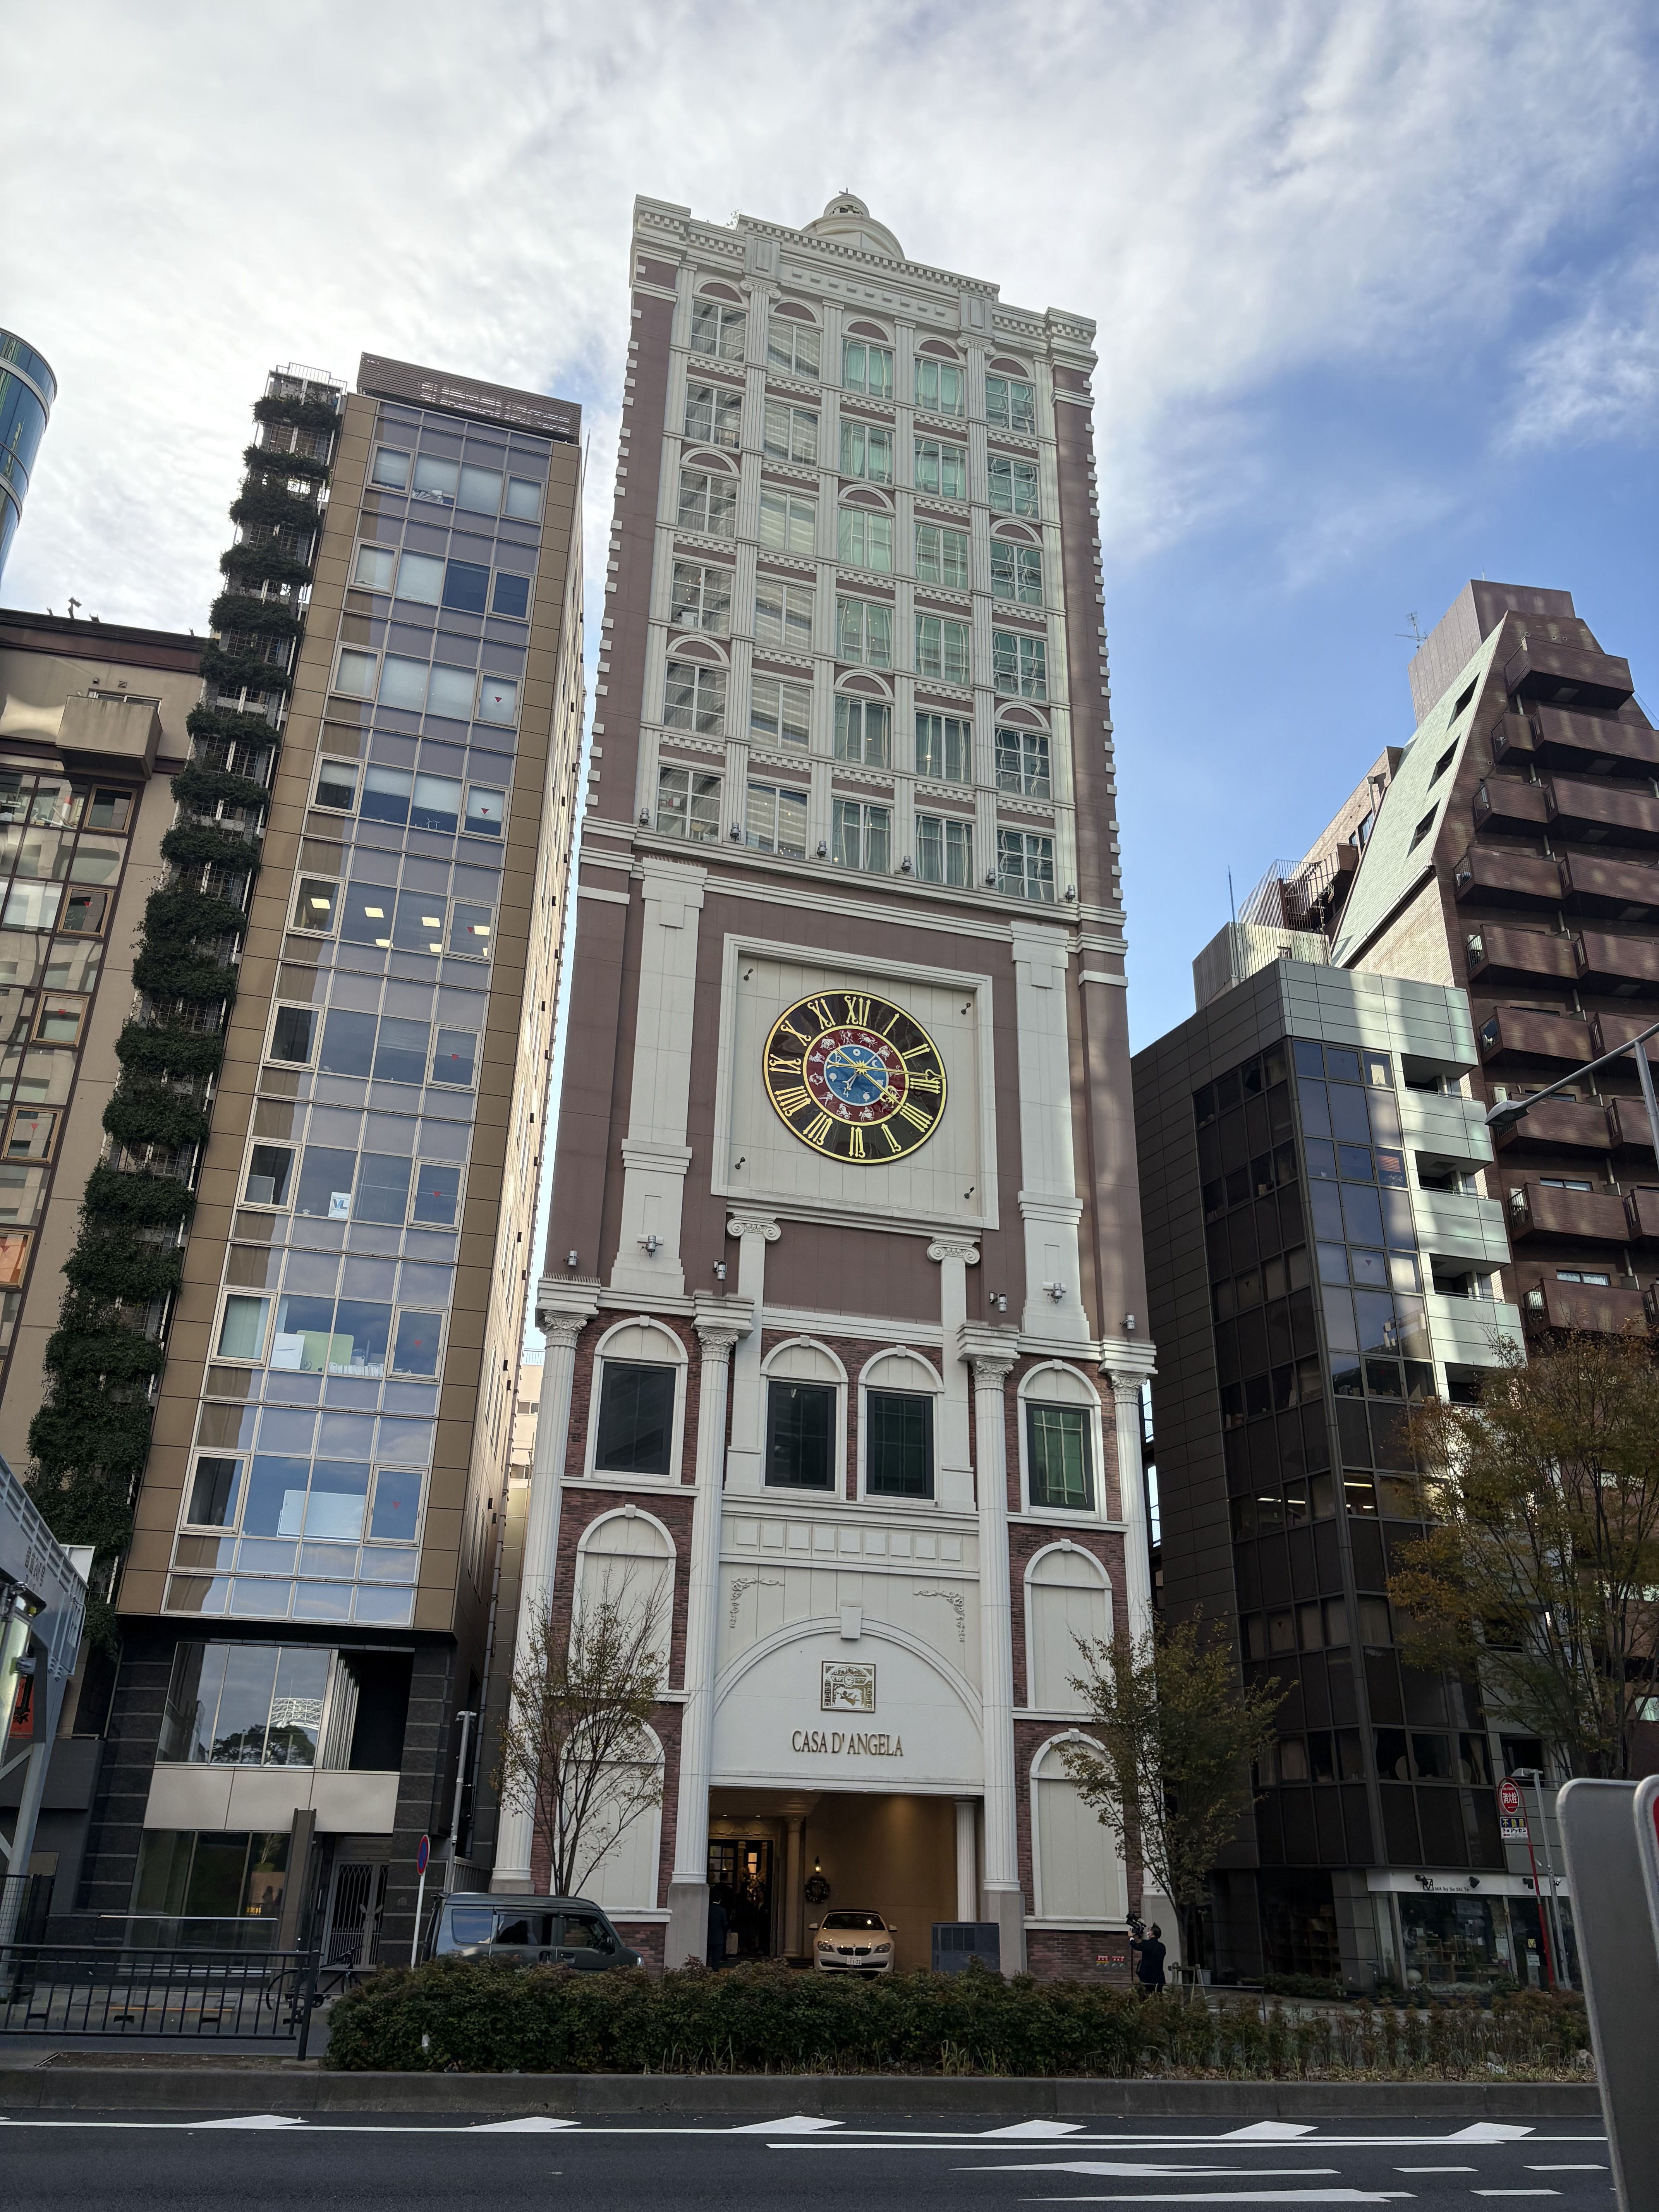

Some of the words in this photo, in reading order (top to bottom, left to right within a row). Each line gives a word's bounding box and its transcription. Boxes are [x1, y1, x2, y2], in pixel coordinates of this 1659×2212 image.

[807, 998, 836, 1030] XI
[844, 995, 871, 1027] XII
[780, 1020, 812, 1047] X
[883, 1013, 900, 1036] I
[902, 1043, 931, 1060] II
[769, 1054, 802, 1074] IX
[333, 1199, 348, 1209] VL
[792, 1731, 828, 1753] CASA
[1503, 1792, 1518, 1803] 消火栓
